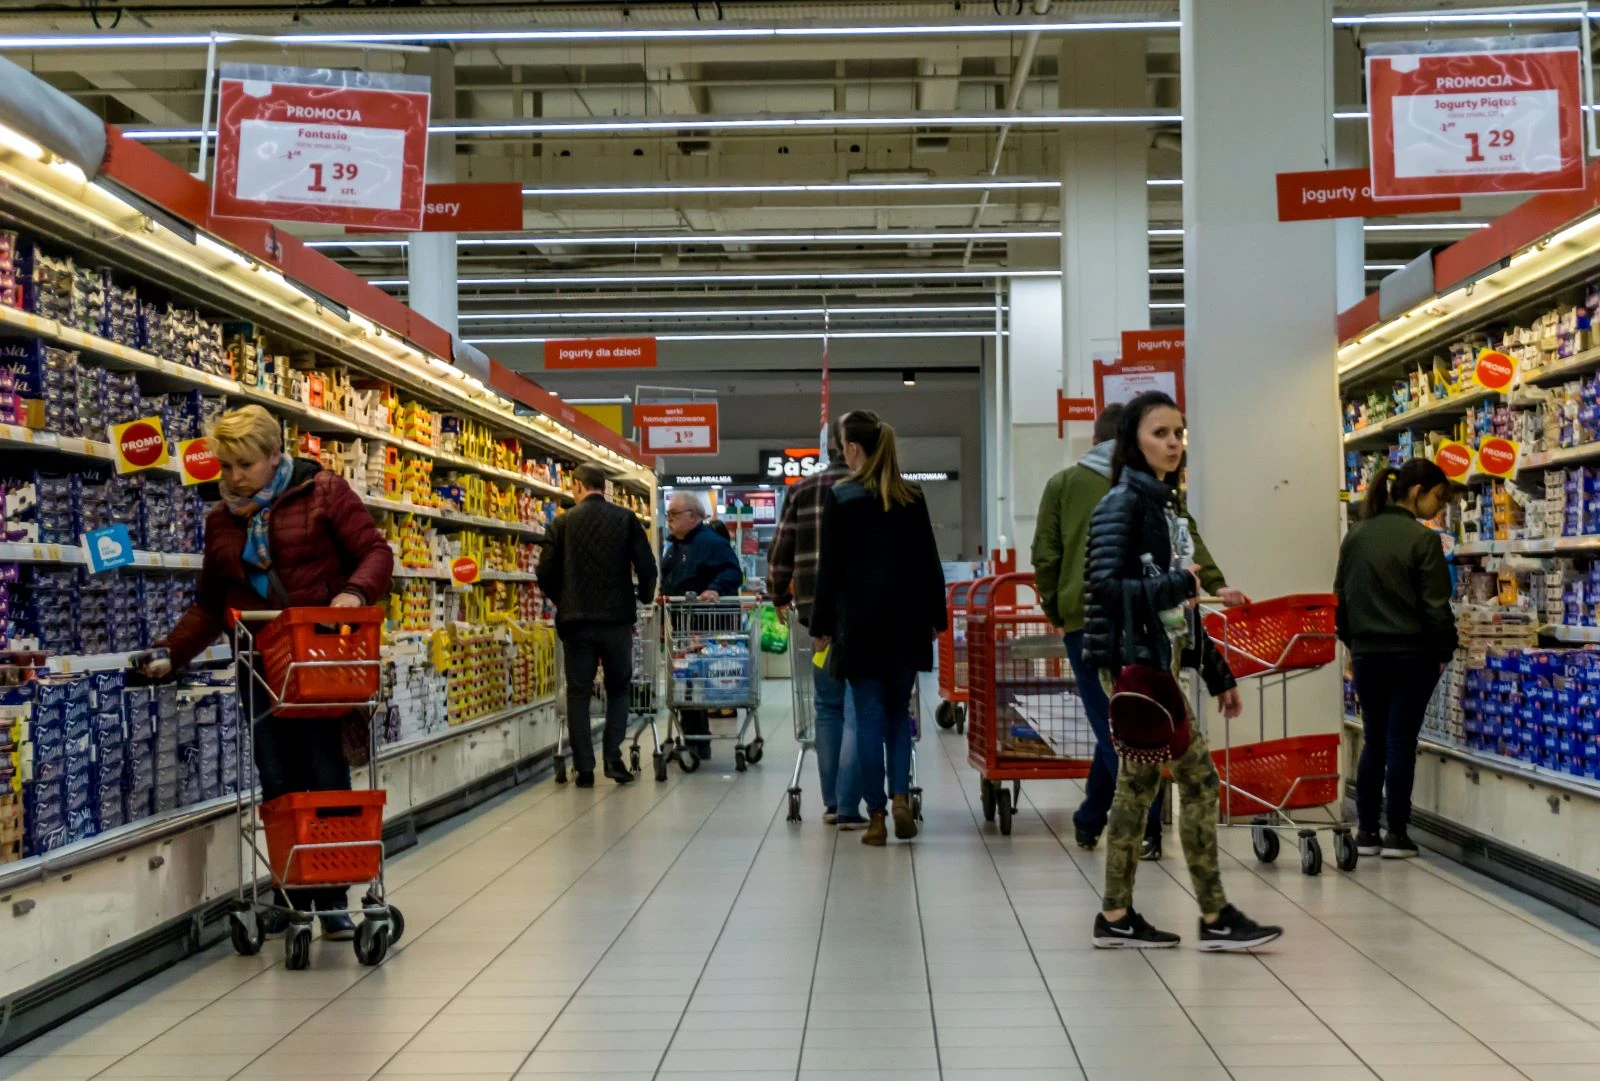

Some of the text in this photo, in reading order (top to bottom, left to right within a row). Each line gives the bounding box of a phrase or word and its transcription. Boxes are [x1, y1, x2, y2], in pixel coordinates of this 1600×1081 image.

[1436, 75, 1513, 89] PROMOCJA
[1434, 99, 1477, 111] Jogurty
[286, 105, 361, 121] PROMOCJA
[297, 128, 347, 140] Fantasia
[1465, 129, 1514, 162] 1 29
[307, 163, 358, 192] 1 39
[1302, 187, 1355, 203] jogurty
[422, 202, 460, 217] sery
[1137, 339, 1172, 350] jogurty
[559, 347, 641, 359] jogurty dla dzieci
[1480, 360, 1511, 375] PROMO
[1068, 405, 1094, 414] jogurty
[643, 415, 706, 424] homogenizowane
[121, 435, 162, 452] PROMO
[1441, 449, 1469, 466] PROMO
[1483, 446, 1513, 460] PROMO
[676, 475, 732, 484] TWOJA PRALNIA
[454, 563, 475, 571] PROMO
